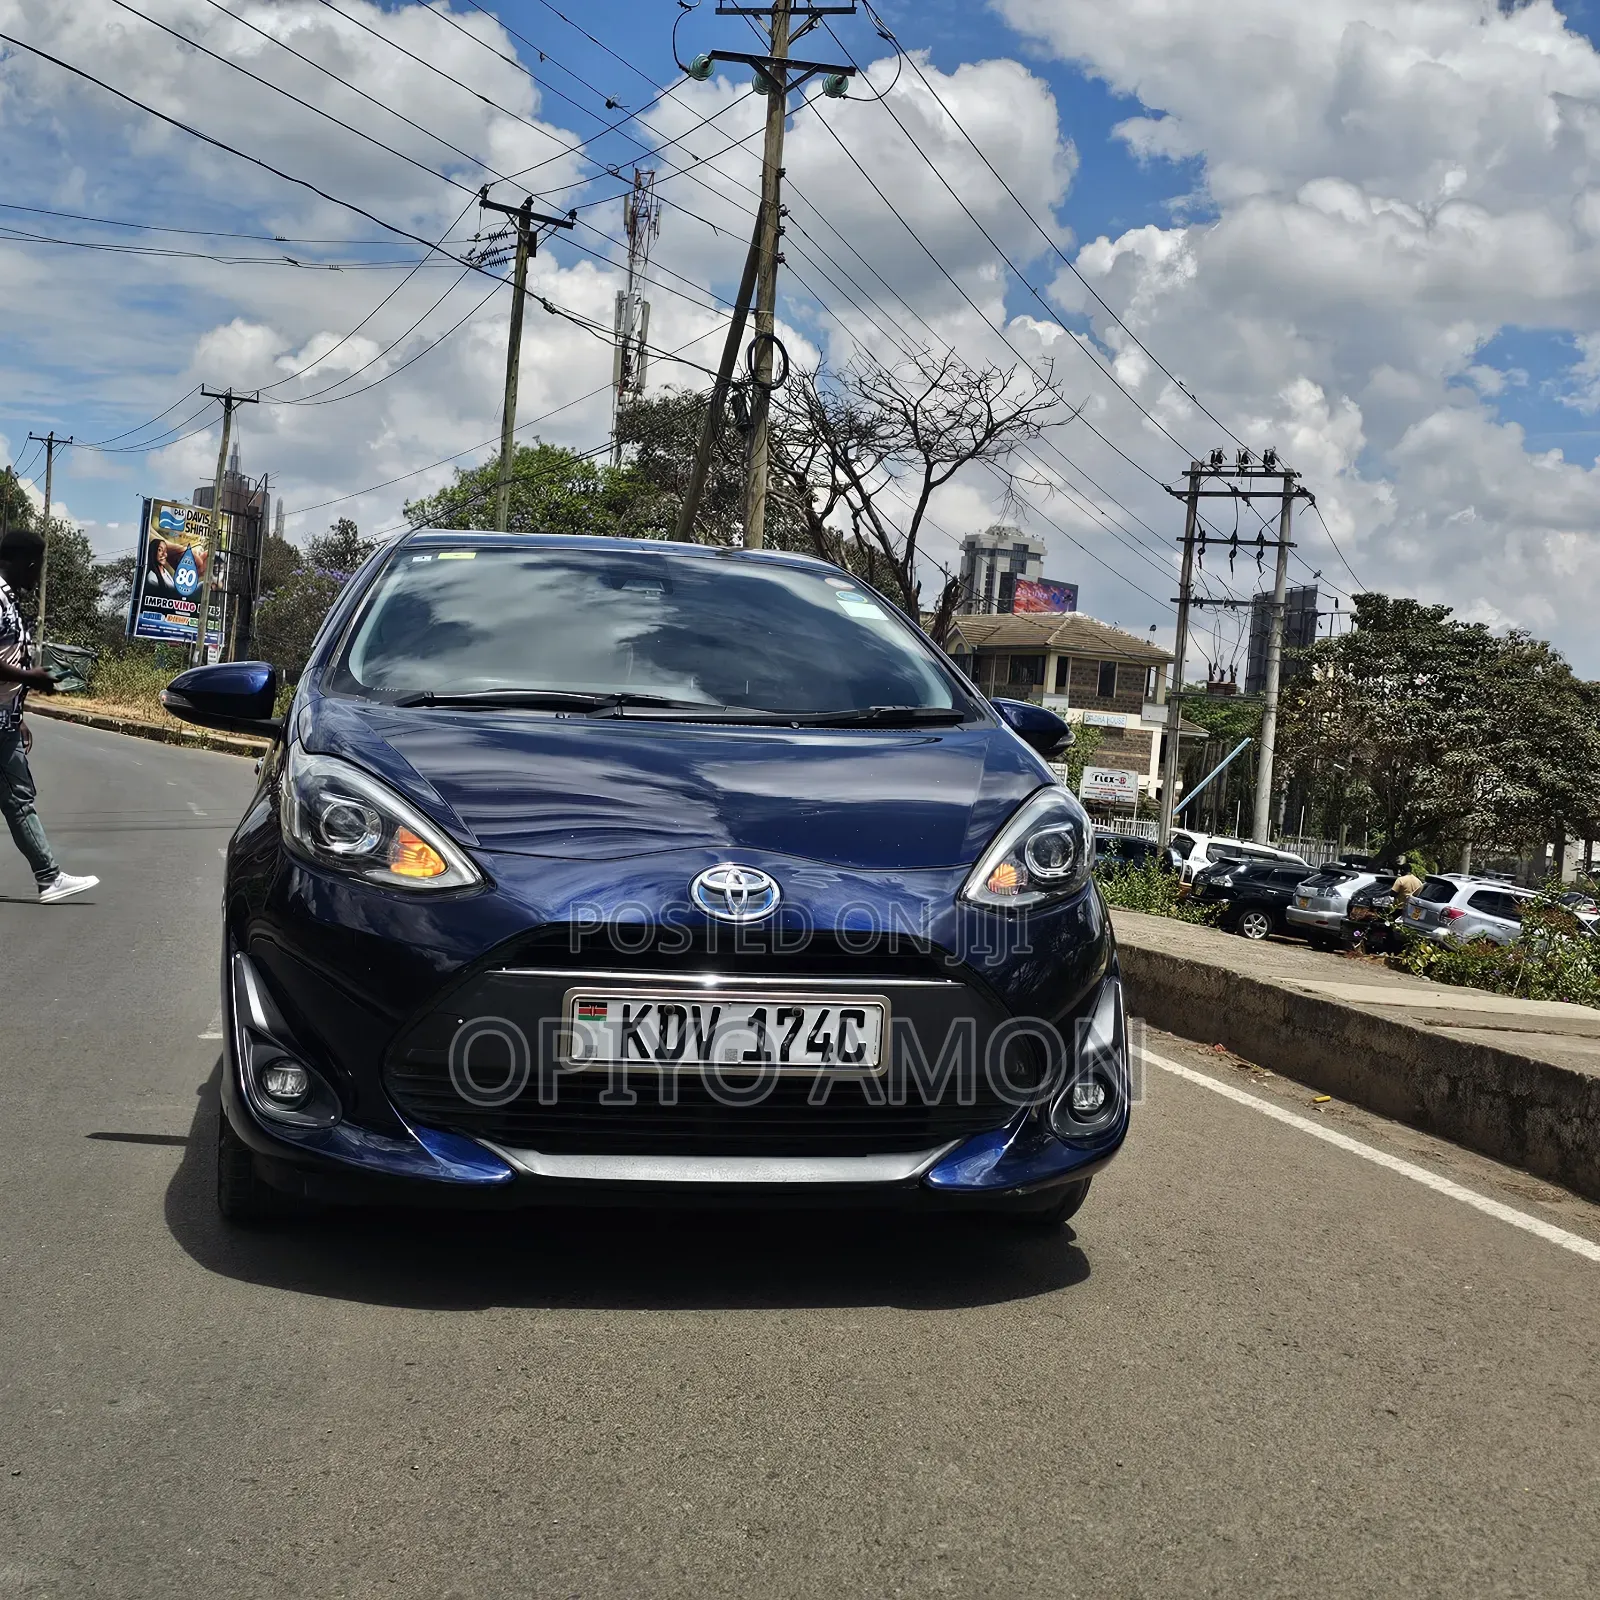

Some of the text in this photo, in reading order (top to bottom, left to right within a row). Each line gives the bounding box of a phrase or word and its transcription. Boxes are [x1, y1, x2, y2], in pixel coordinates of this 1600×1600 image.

[186, 509, 210, 525] DAVIS
[176, 568, 196, 587] 80
[144, 595, 197, 613] IMPROVING
[620, 1002, 721, 1061] KDV
[742, 1006, 867, 1063] 174C
